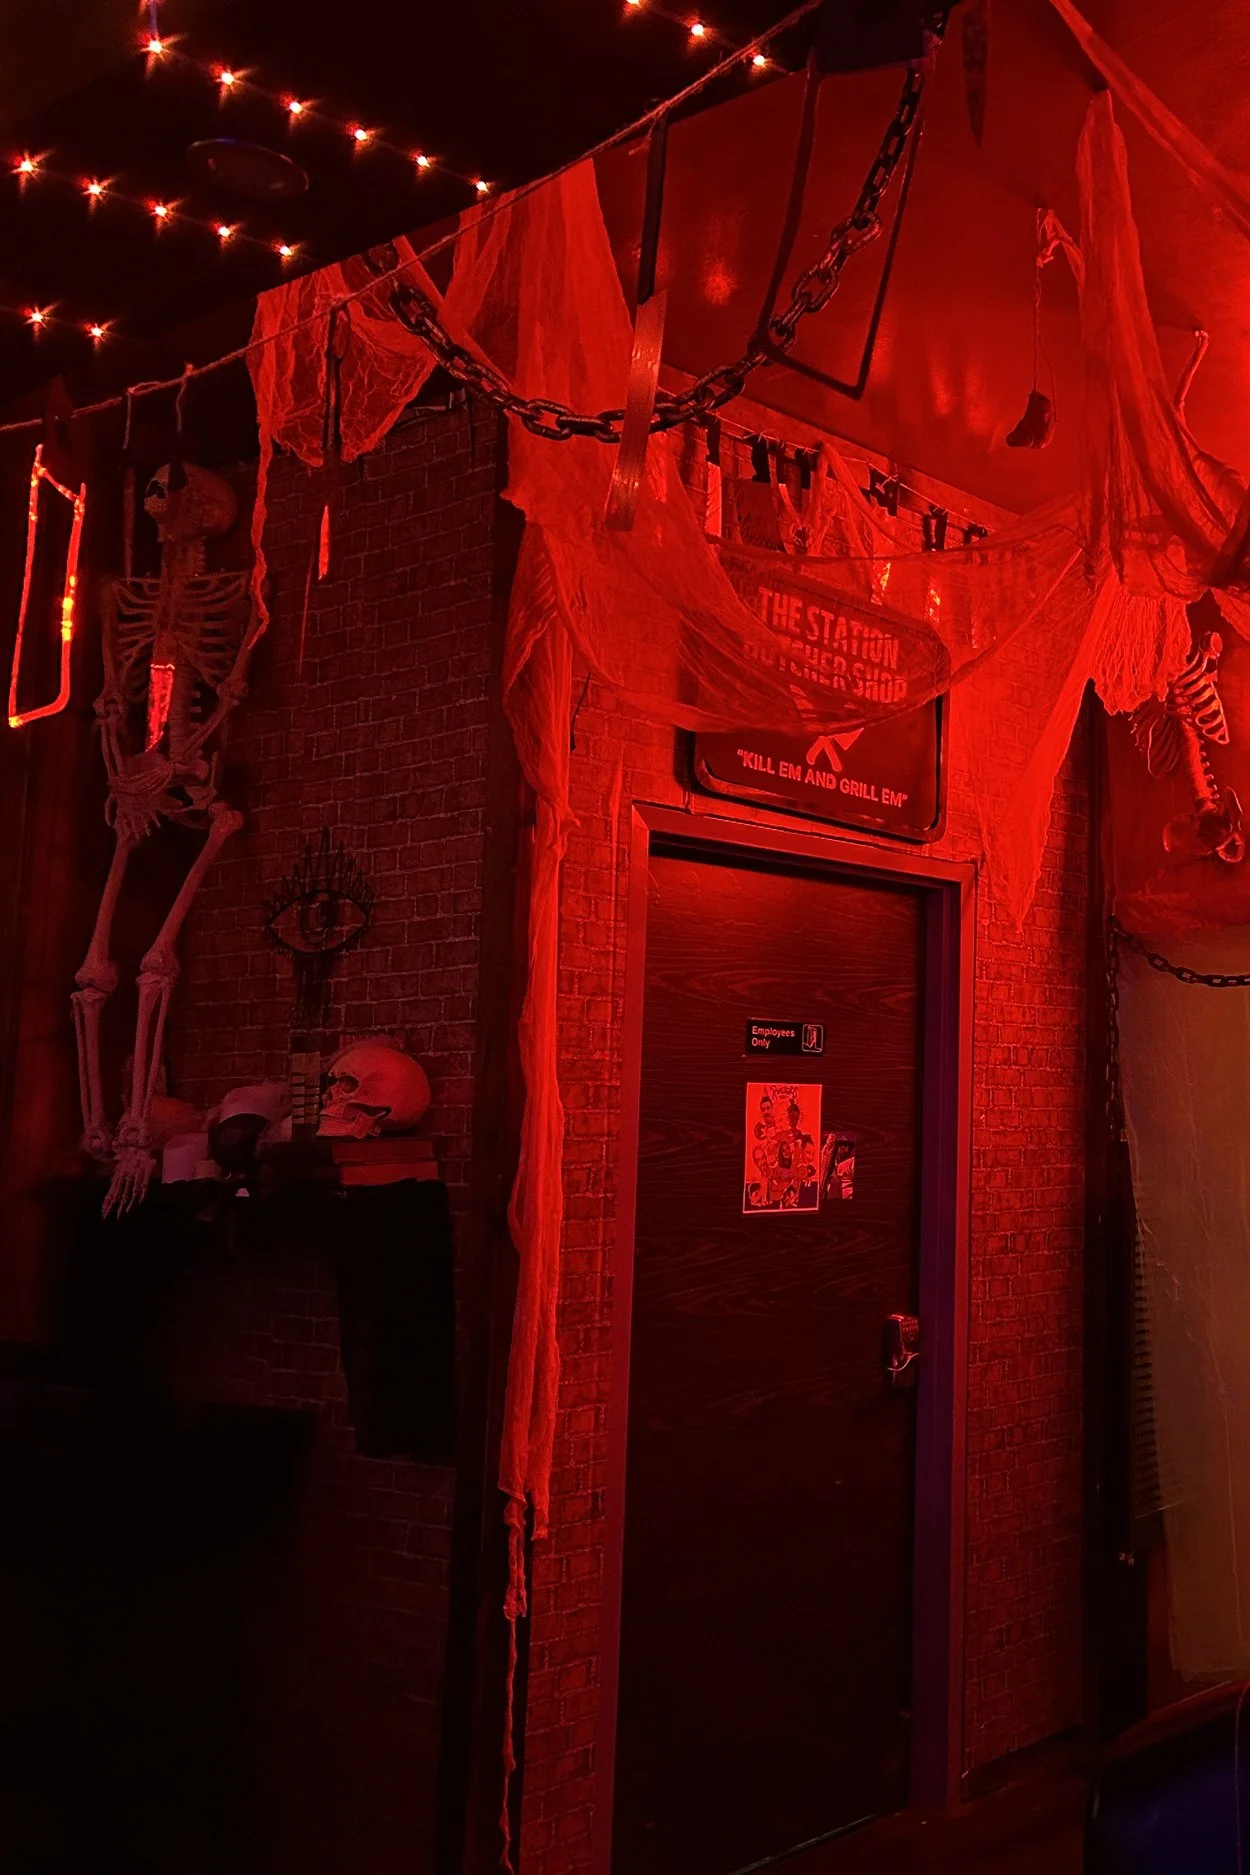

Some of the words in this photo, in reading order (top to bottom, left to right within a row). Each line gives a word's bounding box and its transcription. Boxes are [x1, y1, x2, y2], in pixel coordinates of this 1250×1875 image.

[757, 586, 803, 632] THE
[805, 605, 900, 671] STATION
[852, 661, 908, 704] SHOP
[778, 761, 802, 781] EM
[804, 769, 838, 791] AND
[839, 777, 879, 802] GRILL
[752, 1025, 795, 1038] Employees
[752, 1037, 770, 1049] Only
